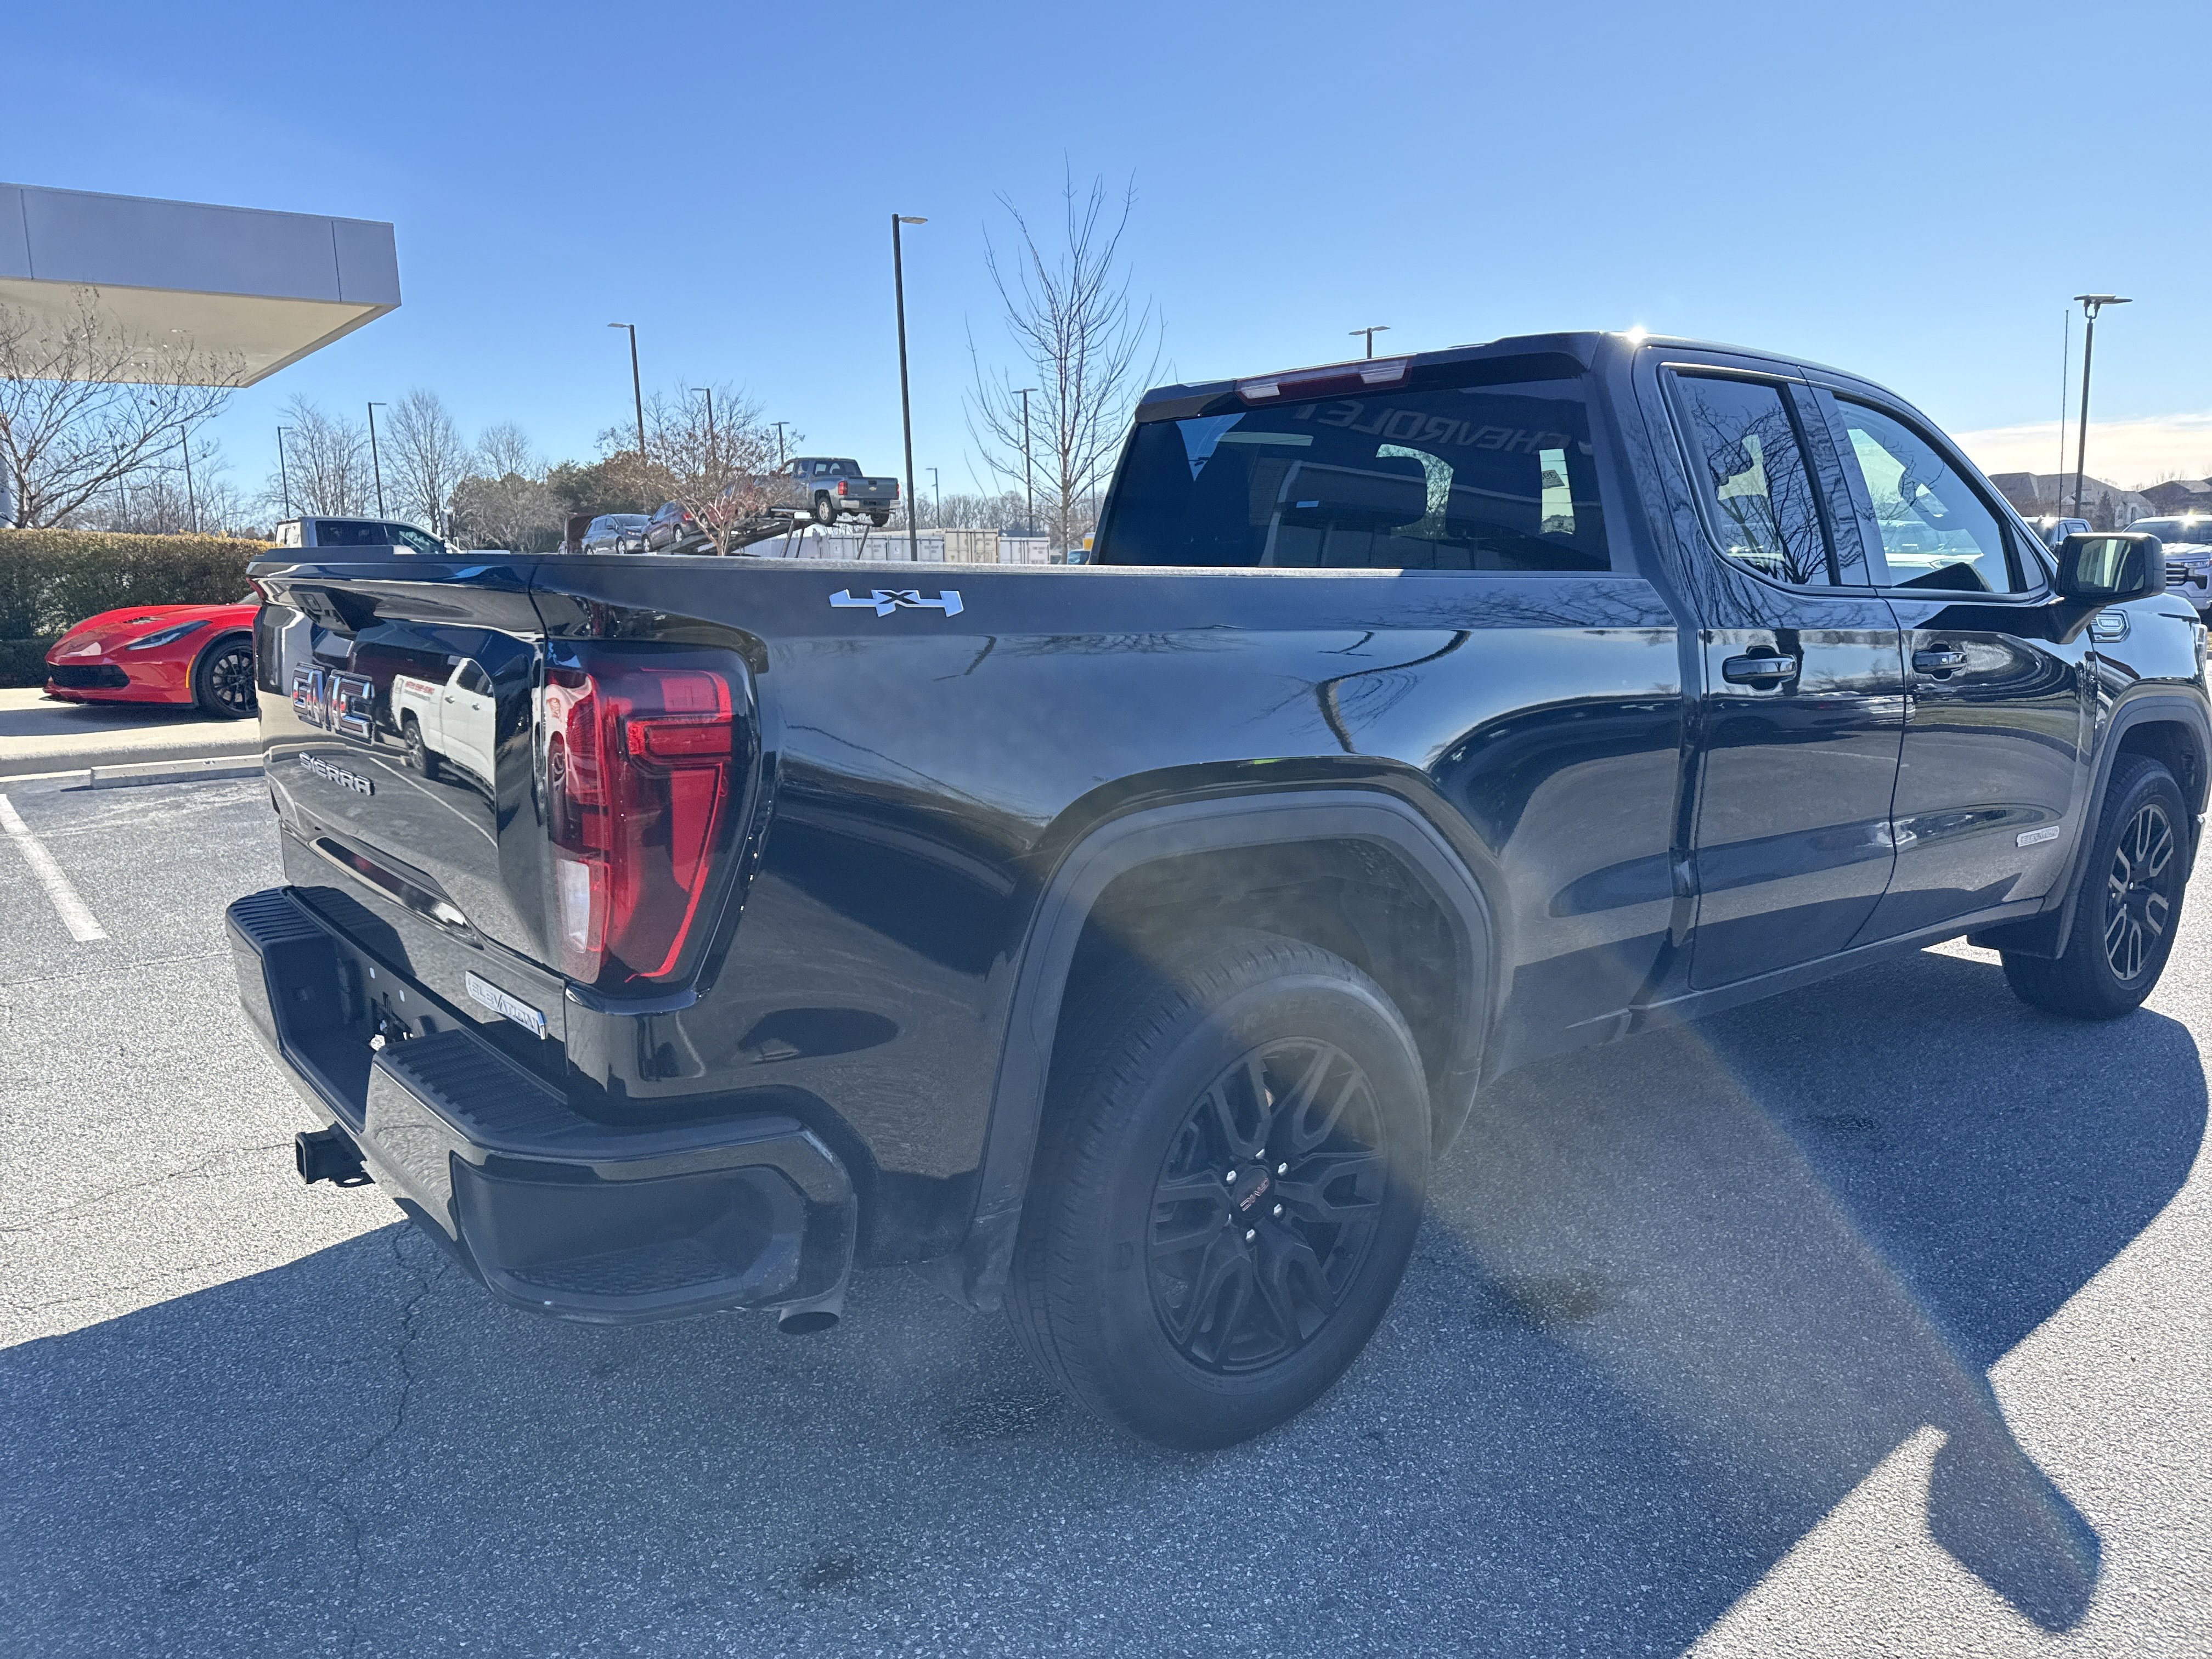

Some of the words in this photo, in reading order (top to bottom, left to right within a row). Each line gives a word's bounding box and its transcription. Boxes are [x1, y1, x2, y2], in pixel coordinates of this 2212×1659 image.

[291, 662, 375, 742] GMC
[299, 752, 375, 795] SIERRA
[471, 981, 537, 1030] ELEVATION
[1240, 1177, 1269, 1212] GMC
